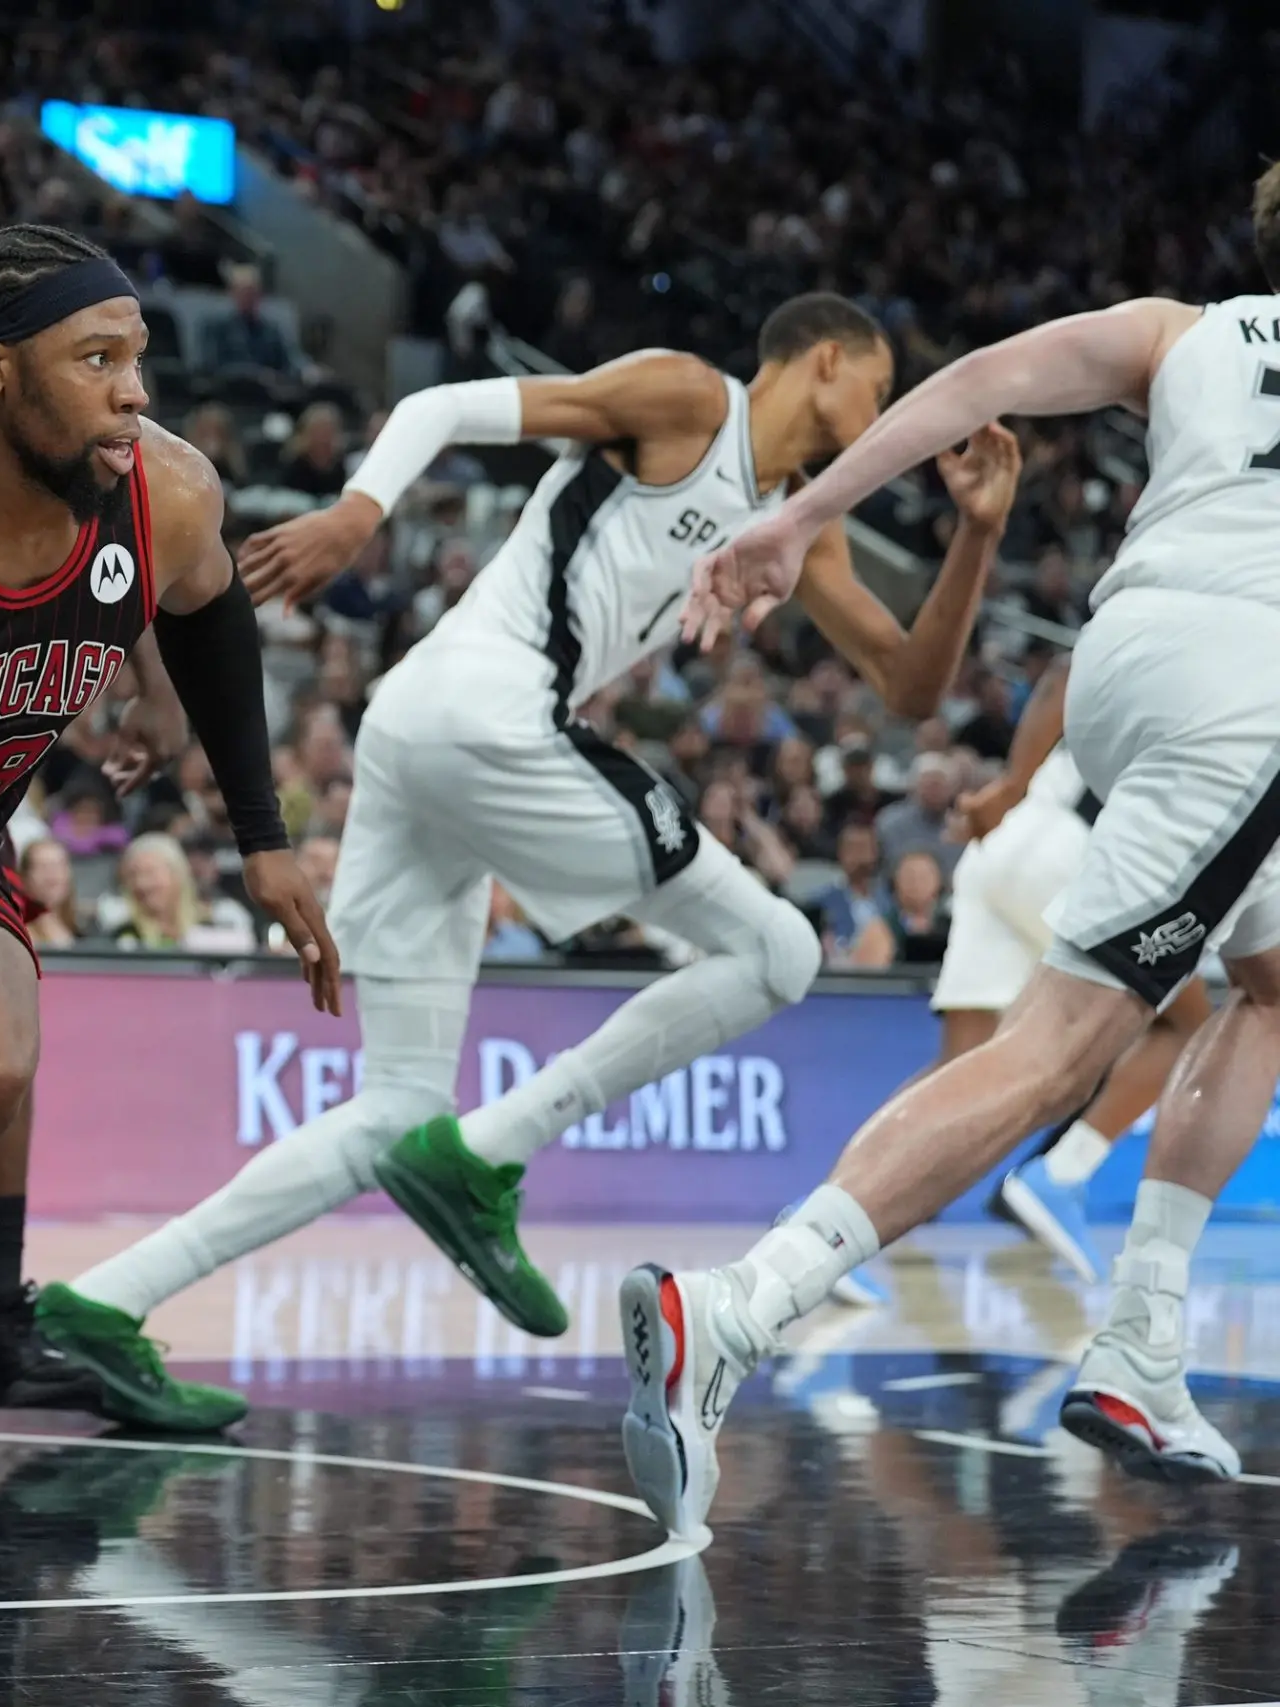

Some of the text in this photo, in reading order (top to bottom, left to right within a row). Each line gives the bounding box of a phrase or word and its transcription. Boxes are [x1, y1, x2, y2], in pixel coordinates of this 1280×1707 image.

[1239, 316, 1280, 344] K
[669, 507, 729, 554] SP
[477, 1037, 787, 1151] PLMER
